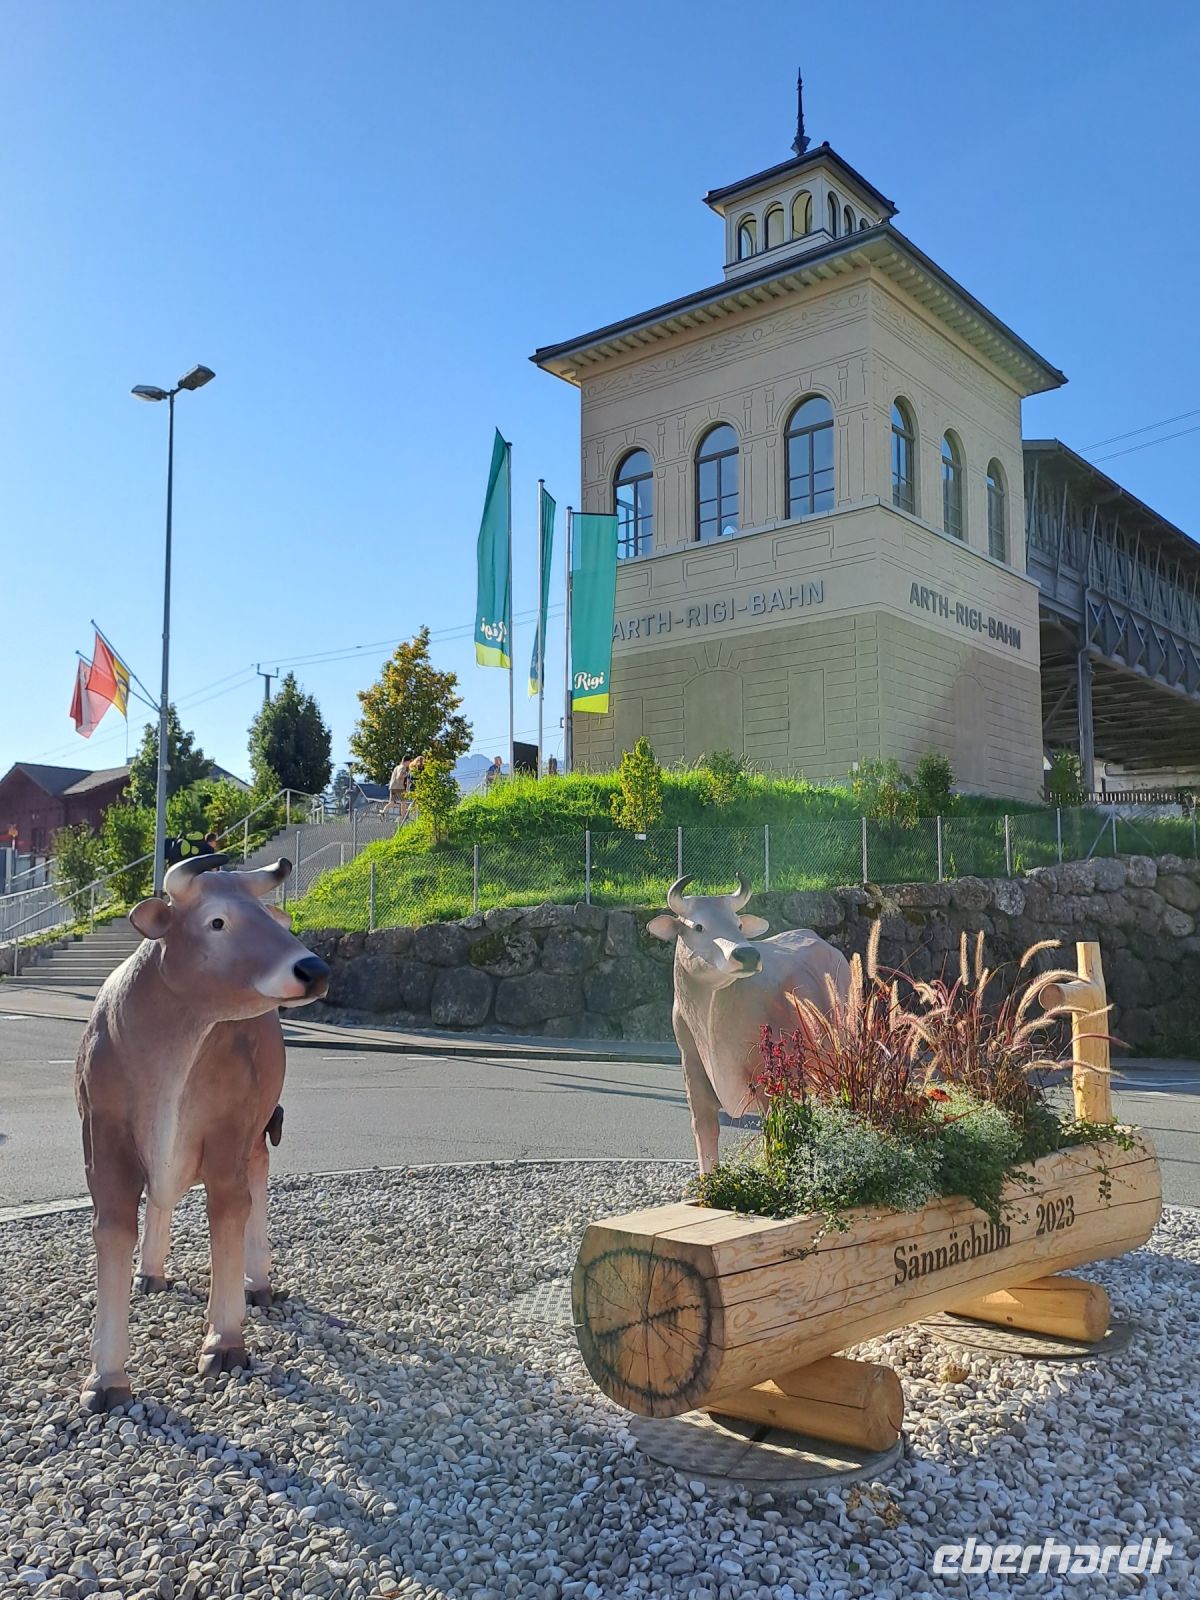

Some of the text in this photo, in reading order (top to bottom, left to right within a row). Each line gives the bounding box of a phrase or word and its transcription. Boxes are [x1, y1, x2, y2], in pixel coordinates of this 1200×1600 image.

[612, 580, 825, 642] ARTH-RIGI-BAHN
[910, 582, 1021, 650] ARTH-RIGI-BAHN
[574, 672, 605, 691] Rigi
[1035, 1195, 1075, 1236] 2023
